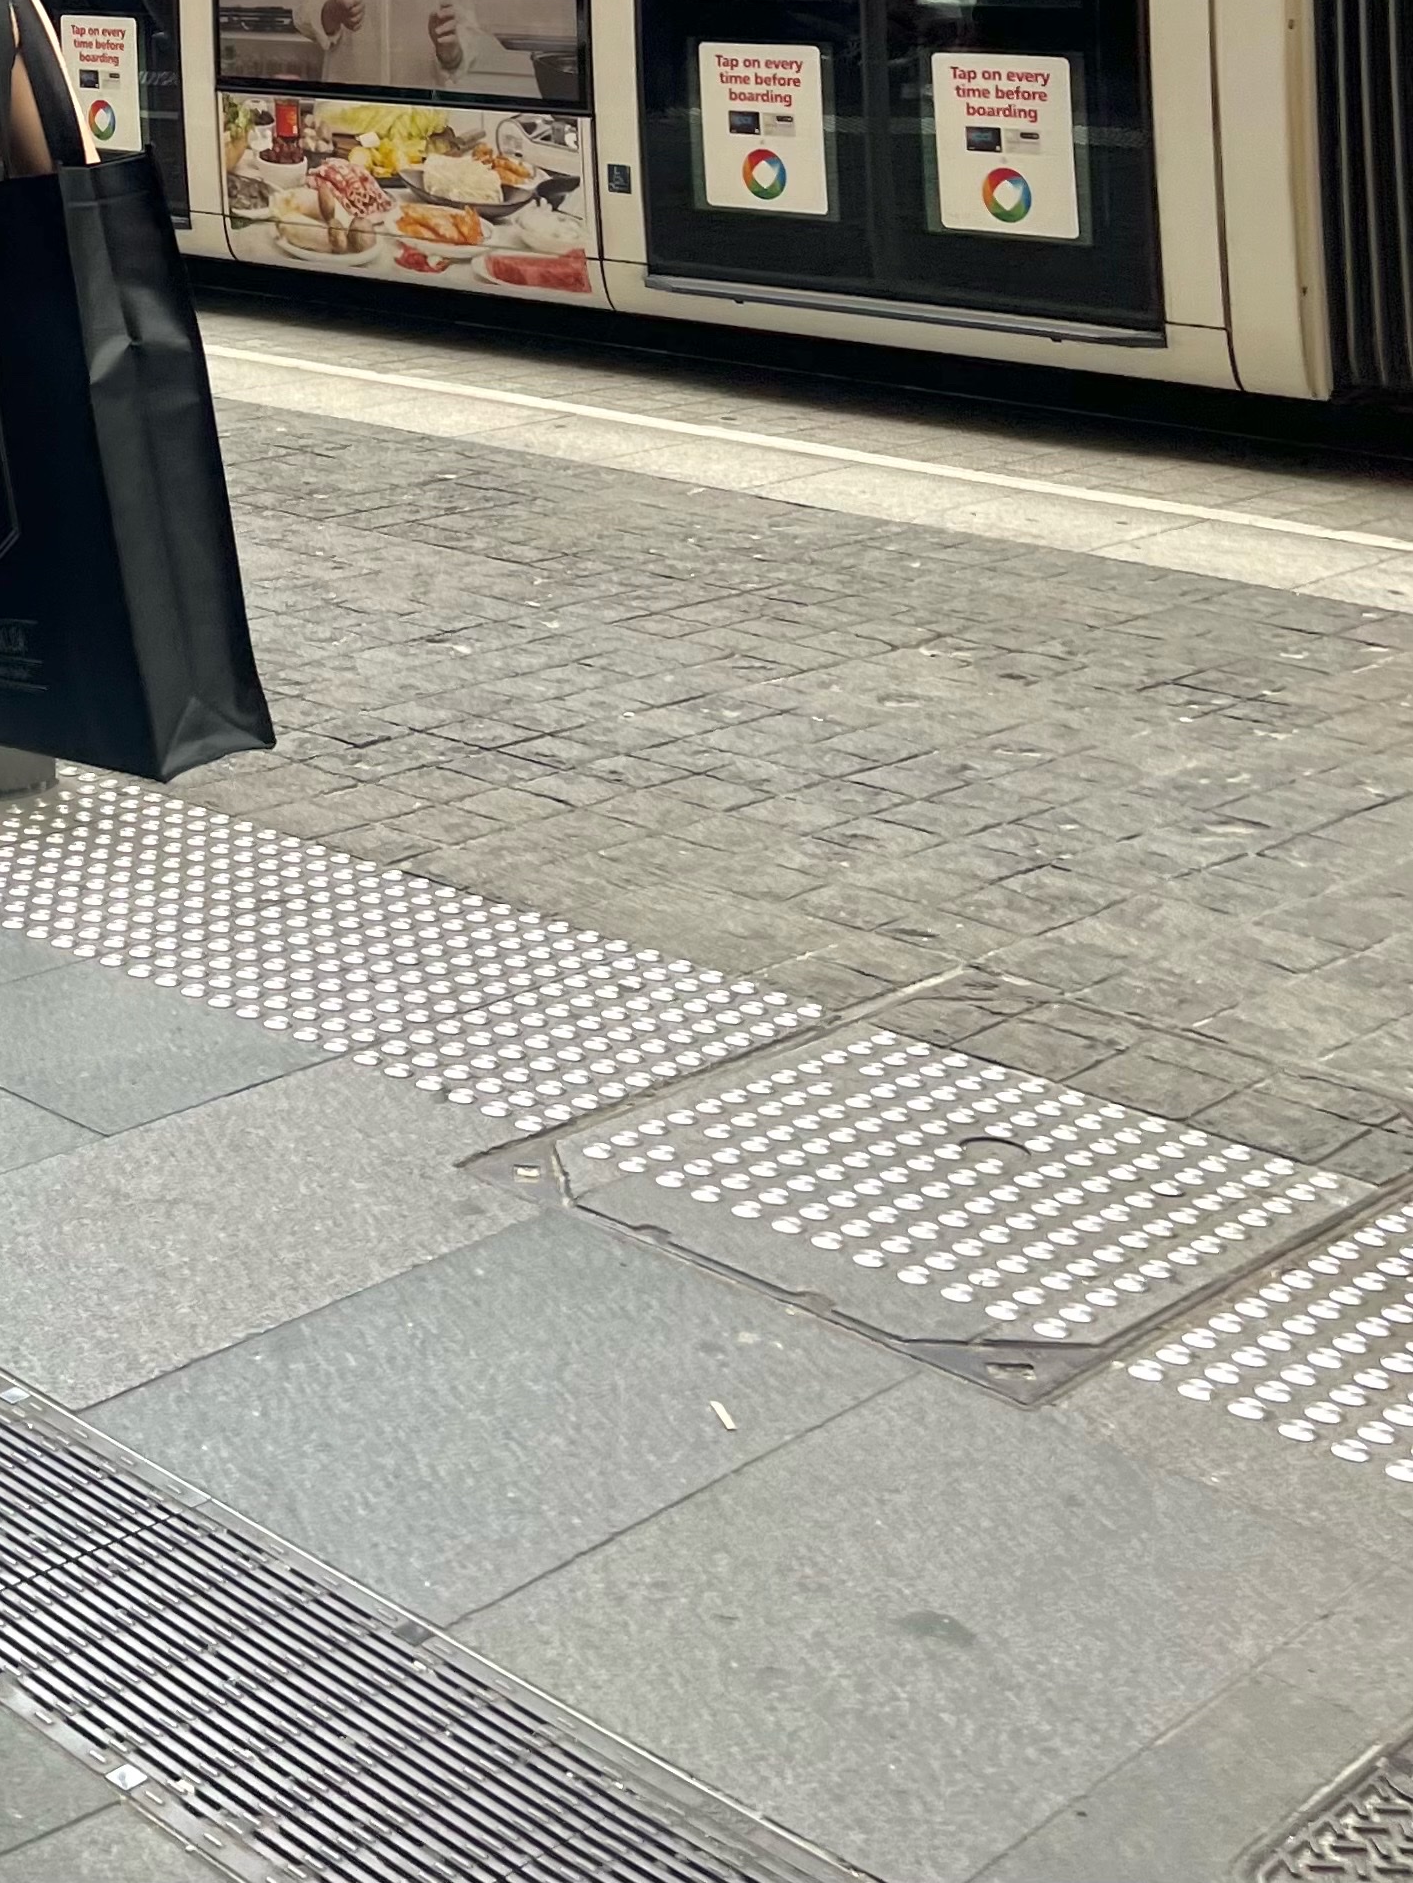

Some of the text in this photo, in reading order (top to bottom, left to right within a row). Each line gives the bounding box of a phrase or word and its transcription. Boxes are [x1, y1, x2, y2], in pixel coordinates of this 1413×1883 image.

[71, 24, 126, 39] Tap on every
[73, 39, 124, 51] time before
[79, 51, 119, 66] boarding
[715, 54, 803, 73] Tap on every
[720, 71, 801, 87] time before
[950, 66, 1050, 87] Tap on every
[728, 88, 793, 107] boarding
[955, 83, 1047, 101] time before
[965, 102, 1038, 123] boarding
